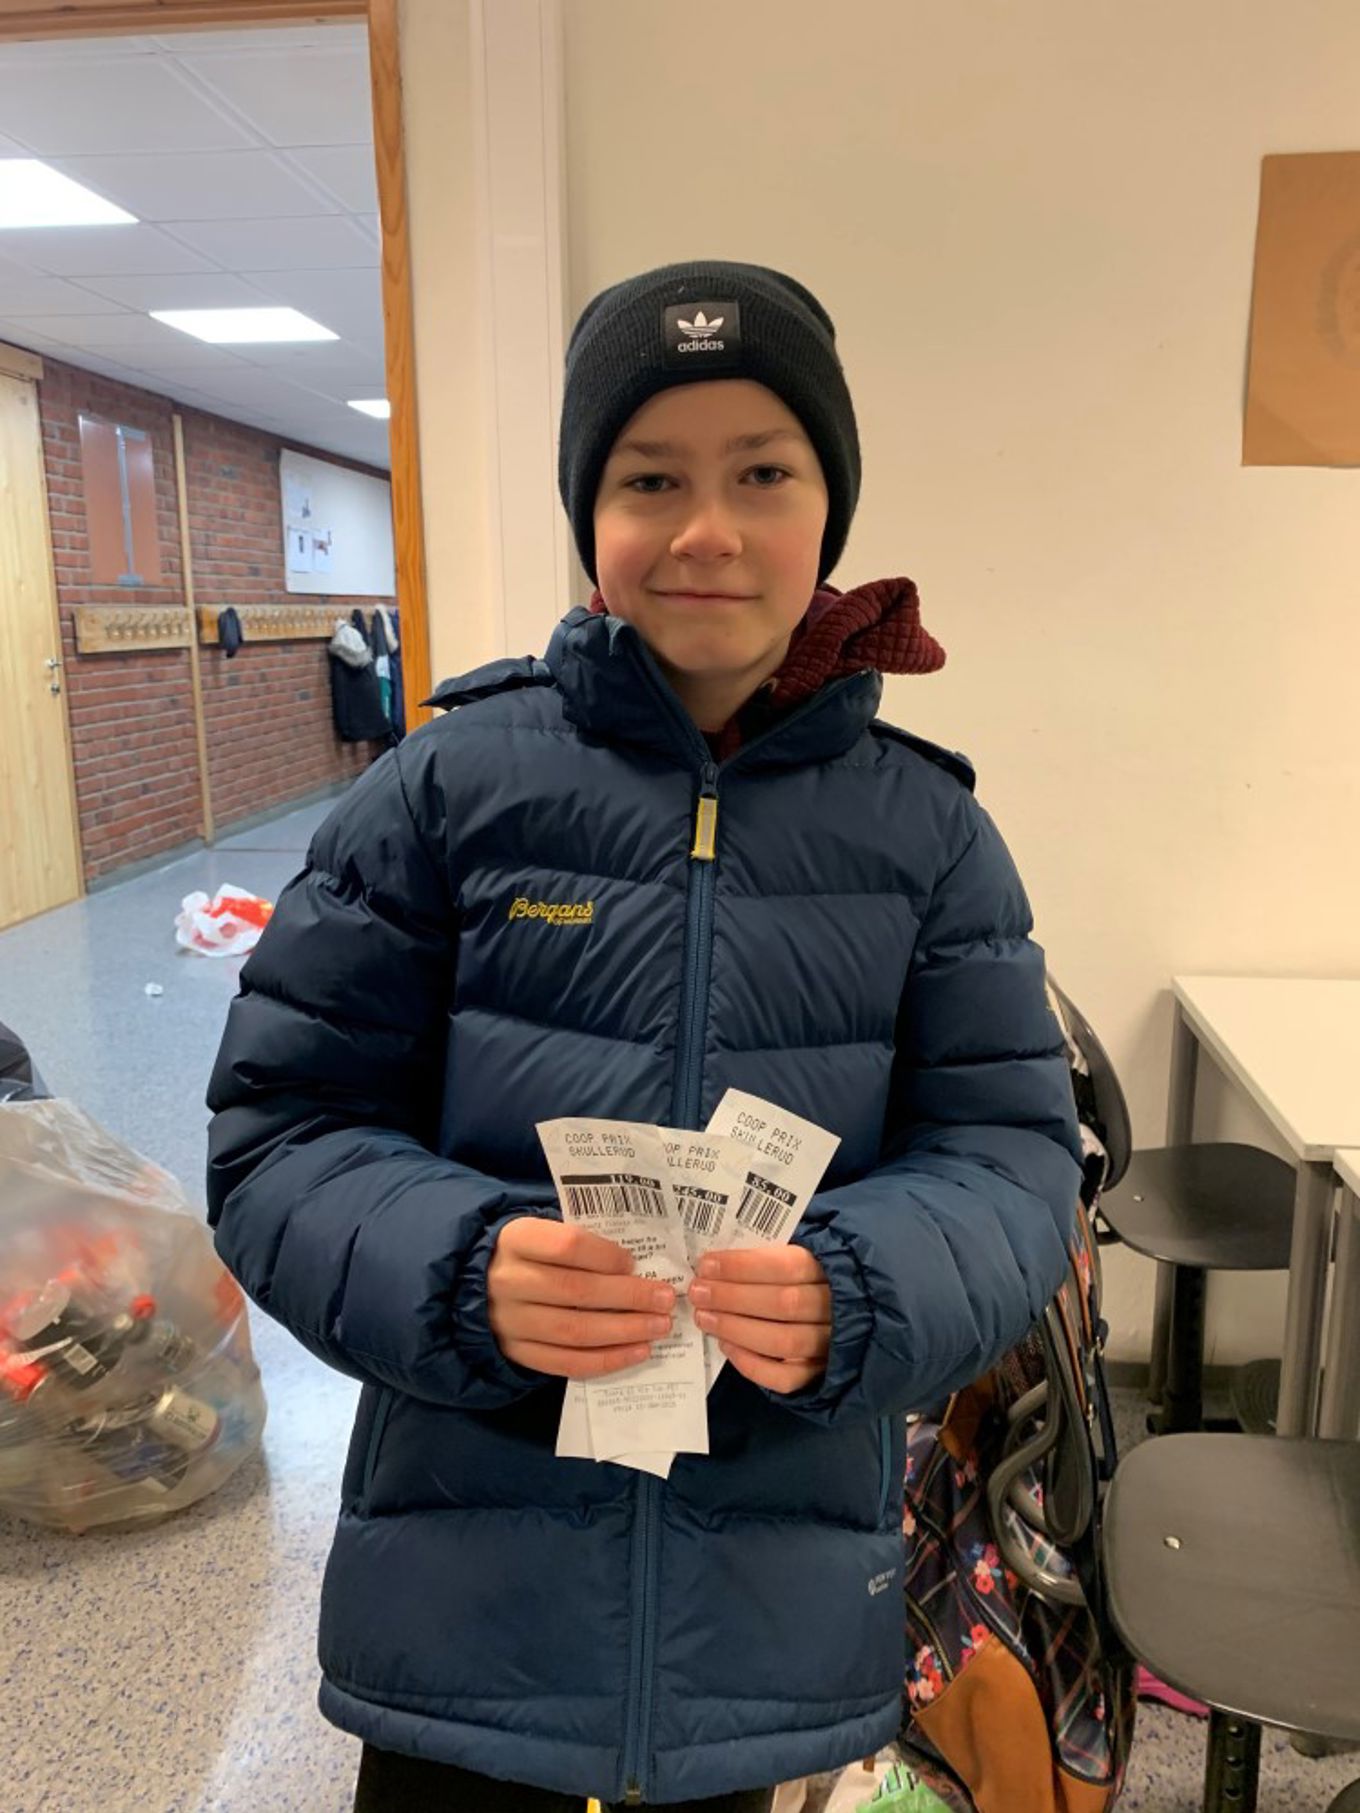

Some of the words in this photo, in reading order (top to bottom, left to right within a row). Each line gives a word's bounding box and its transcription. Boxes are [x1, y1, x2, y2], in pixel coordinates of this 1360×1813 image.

[677, 339, 725, 353] adidas
[509, 898, 593, 924] Bergans
[565, 1132, 594, 1144] COOP
[602, 1134, 633, 1146] PRIX
[737, 1111, 767, 1131] COOP
[770, 1127, 802, 1151] PRIX
[688, 1145, 721, 1160] PRIX
[751, 1176, 790, 1202] 85.00
